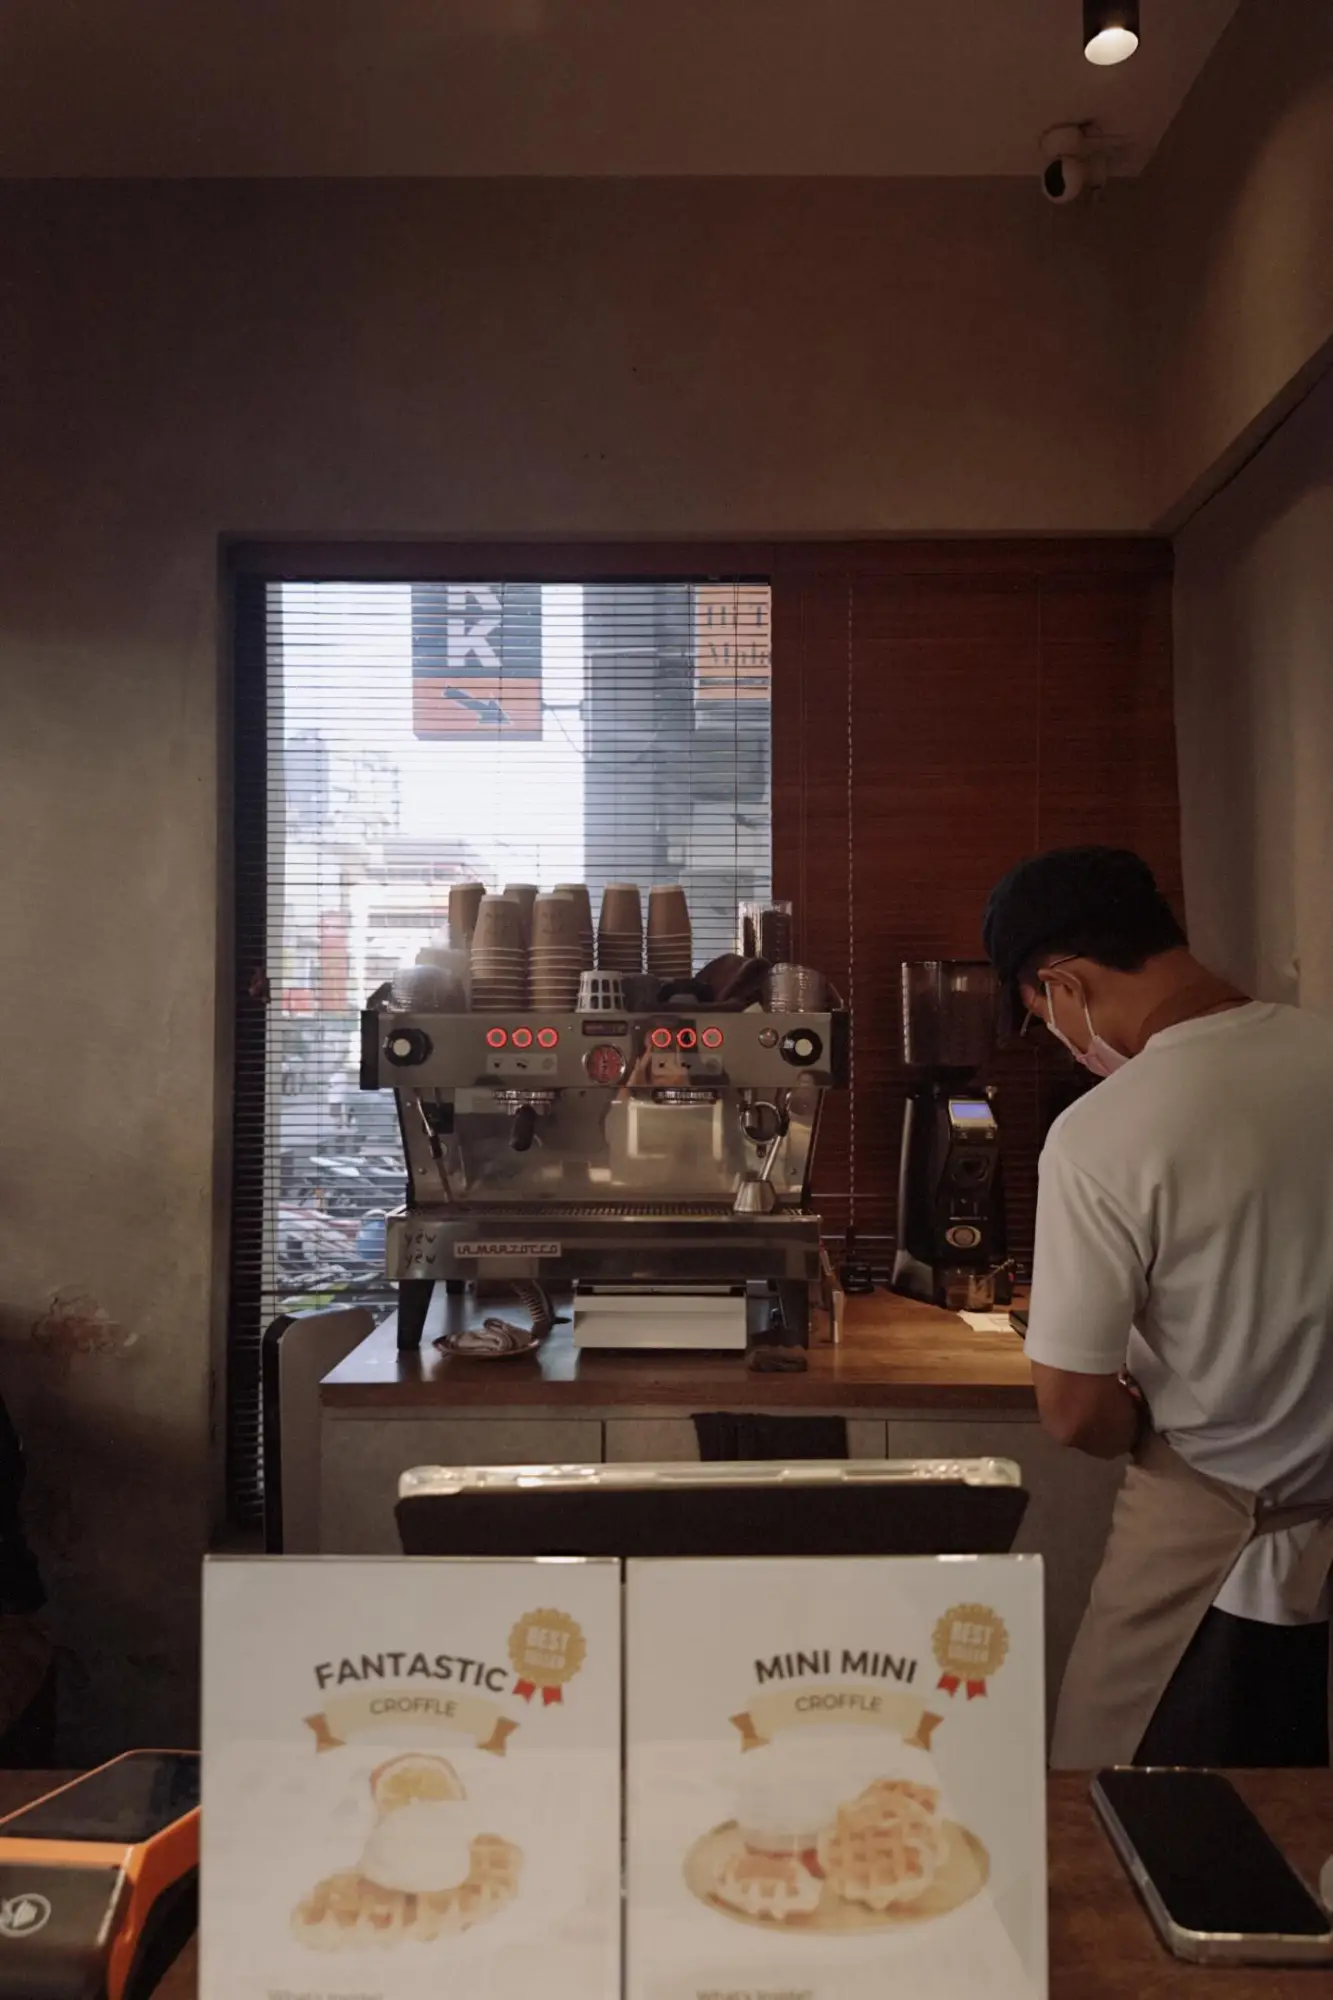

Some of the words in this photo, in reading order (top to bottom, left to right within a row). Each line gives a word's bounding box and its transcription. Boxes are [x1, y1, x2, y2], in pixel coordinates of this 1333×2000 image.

[314, 1651, 509, 1692] FANTASTIC
[755, 1650, 831, 1684] MINI
[841, 1649, 918, 1684] MINI
[369, 1696, 459, 1717] CROFFLE
[795, 1693, 884, 1713] CROFFLE
